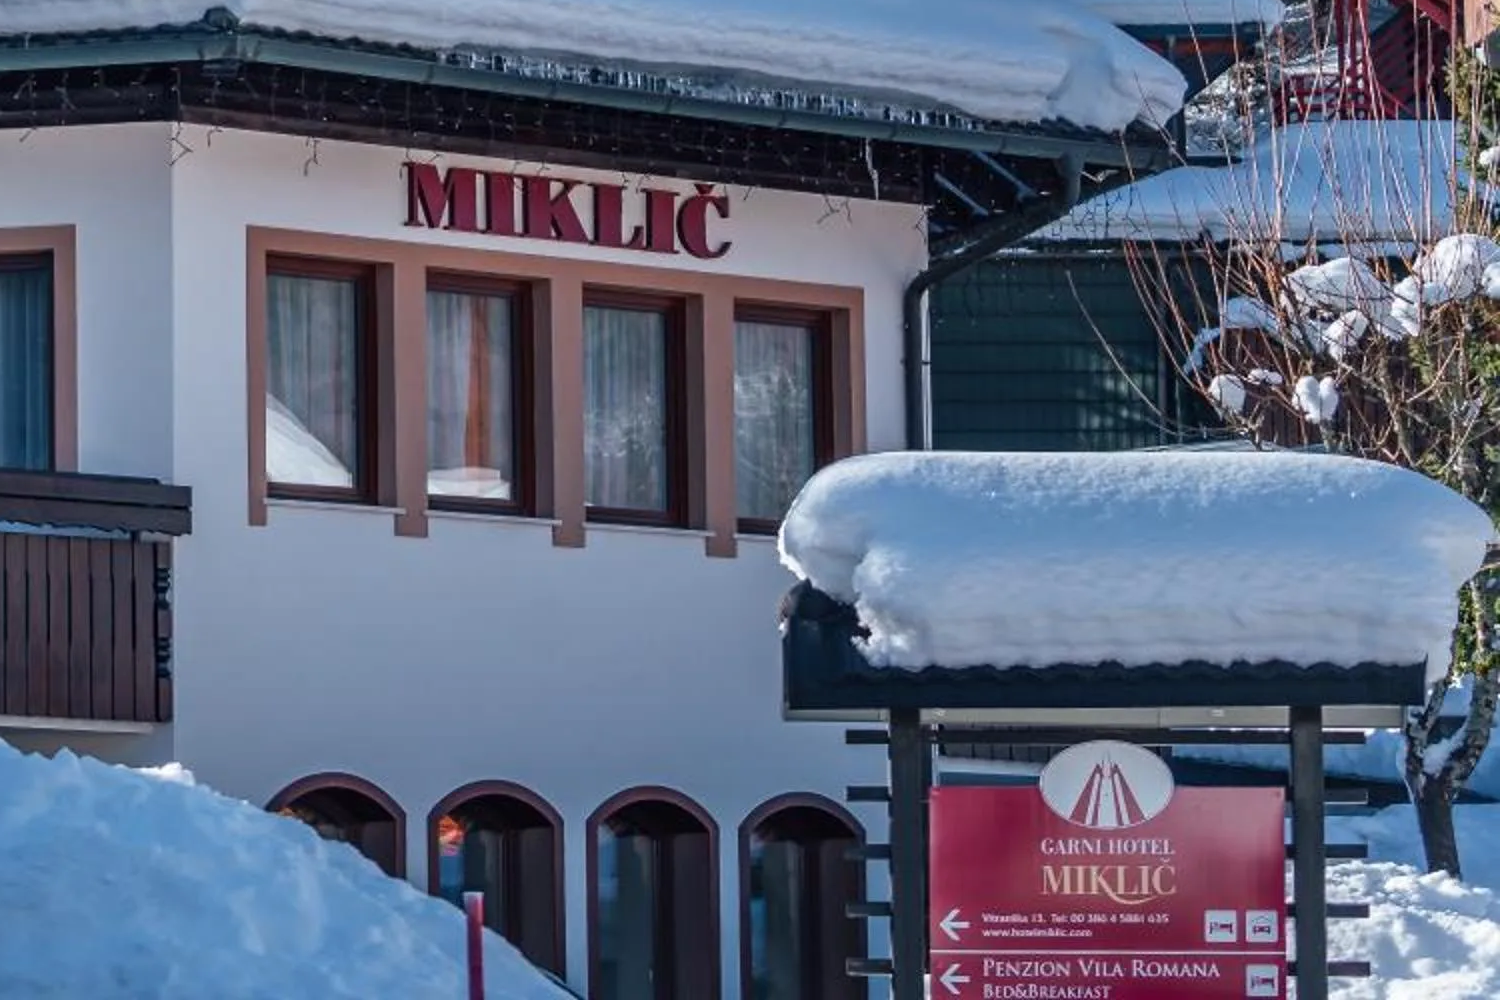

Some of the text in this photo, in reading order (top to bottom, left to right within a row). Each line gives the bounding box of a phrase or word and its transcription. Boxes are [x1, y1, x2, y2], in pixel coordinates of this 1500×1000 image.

[402, 161, 732, 259] MIKLIČ
[1041, 838, 1175, 855] GARNI HOTEL
[1040, 857, 1176, 904] MIKLIČ
[983, 959, 1220, 977] PENZION VILA ROMANA
[983, 983, 1111, 999] BED&BREAKFAST
